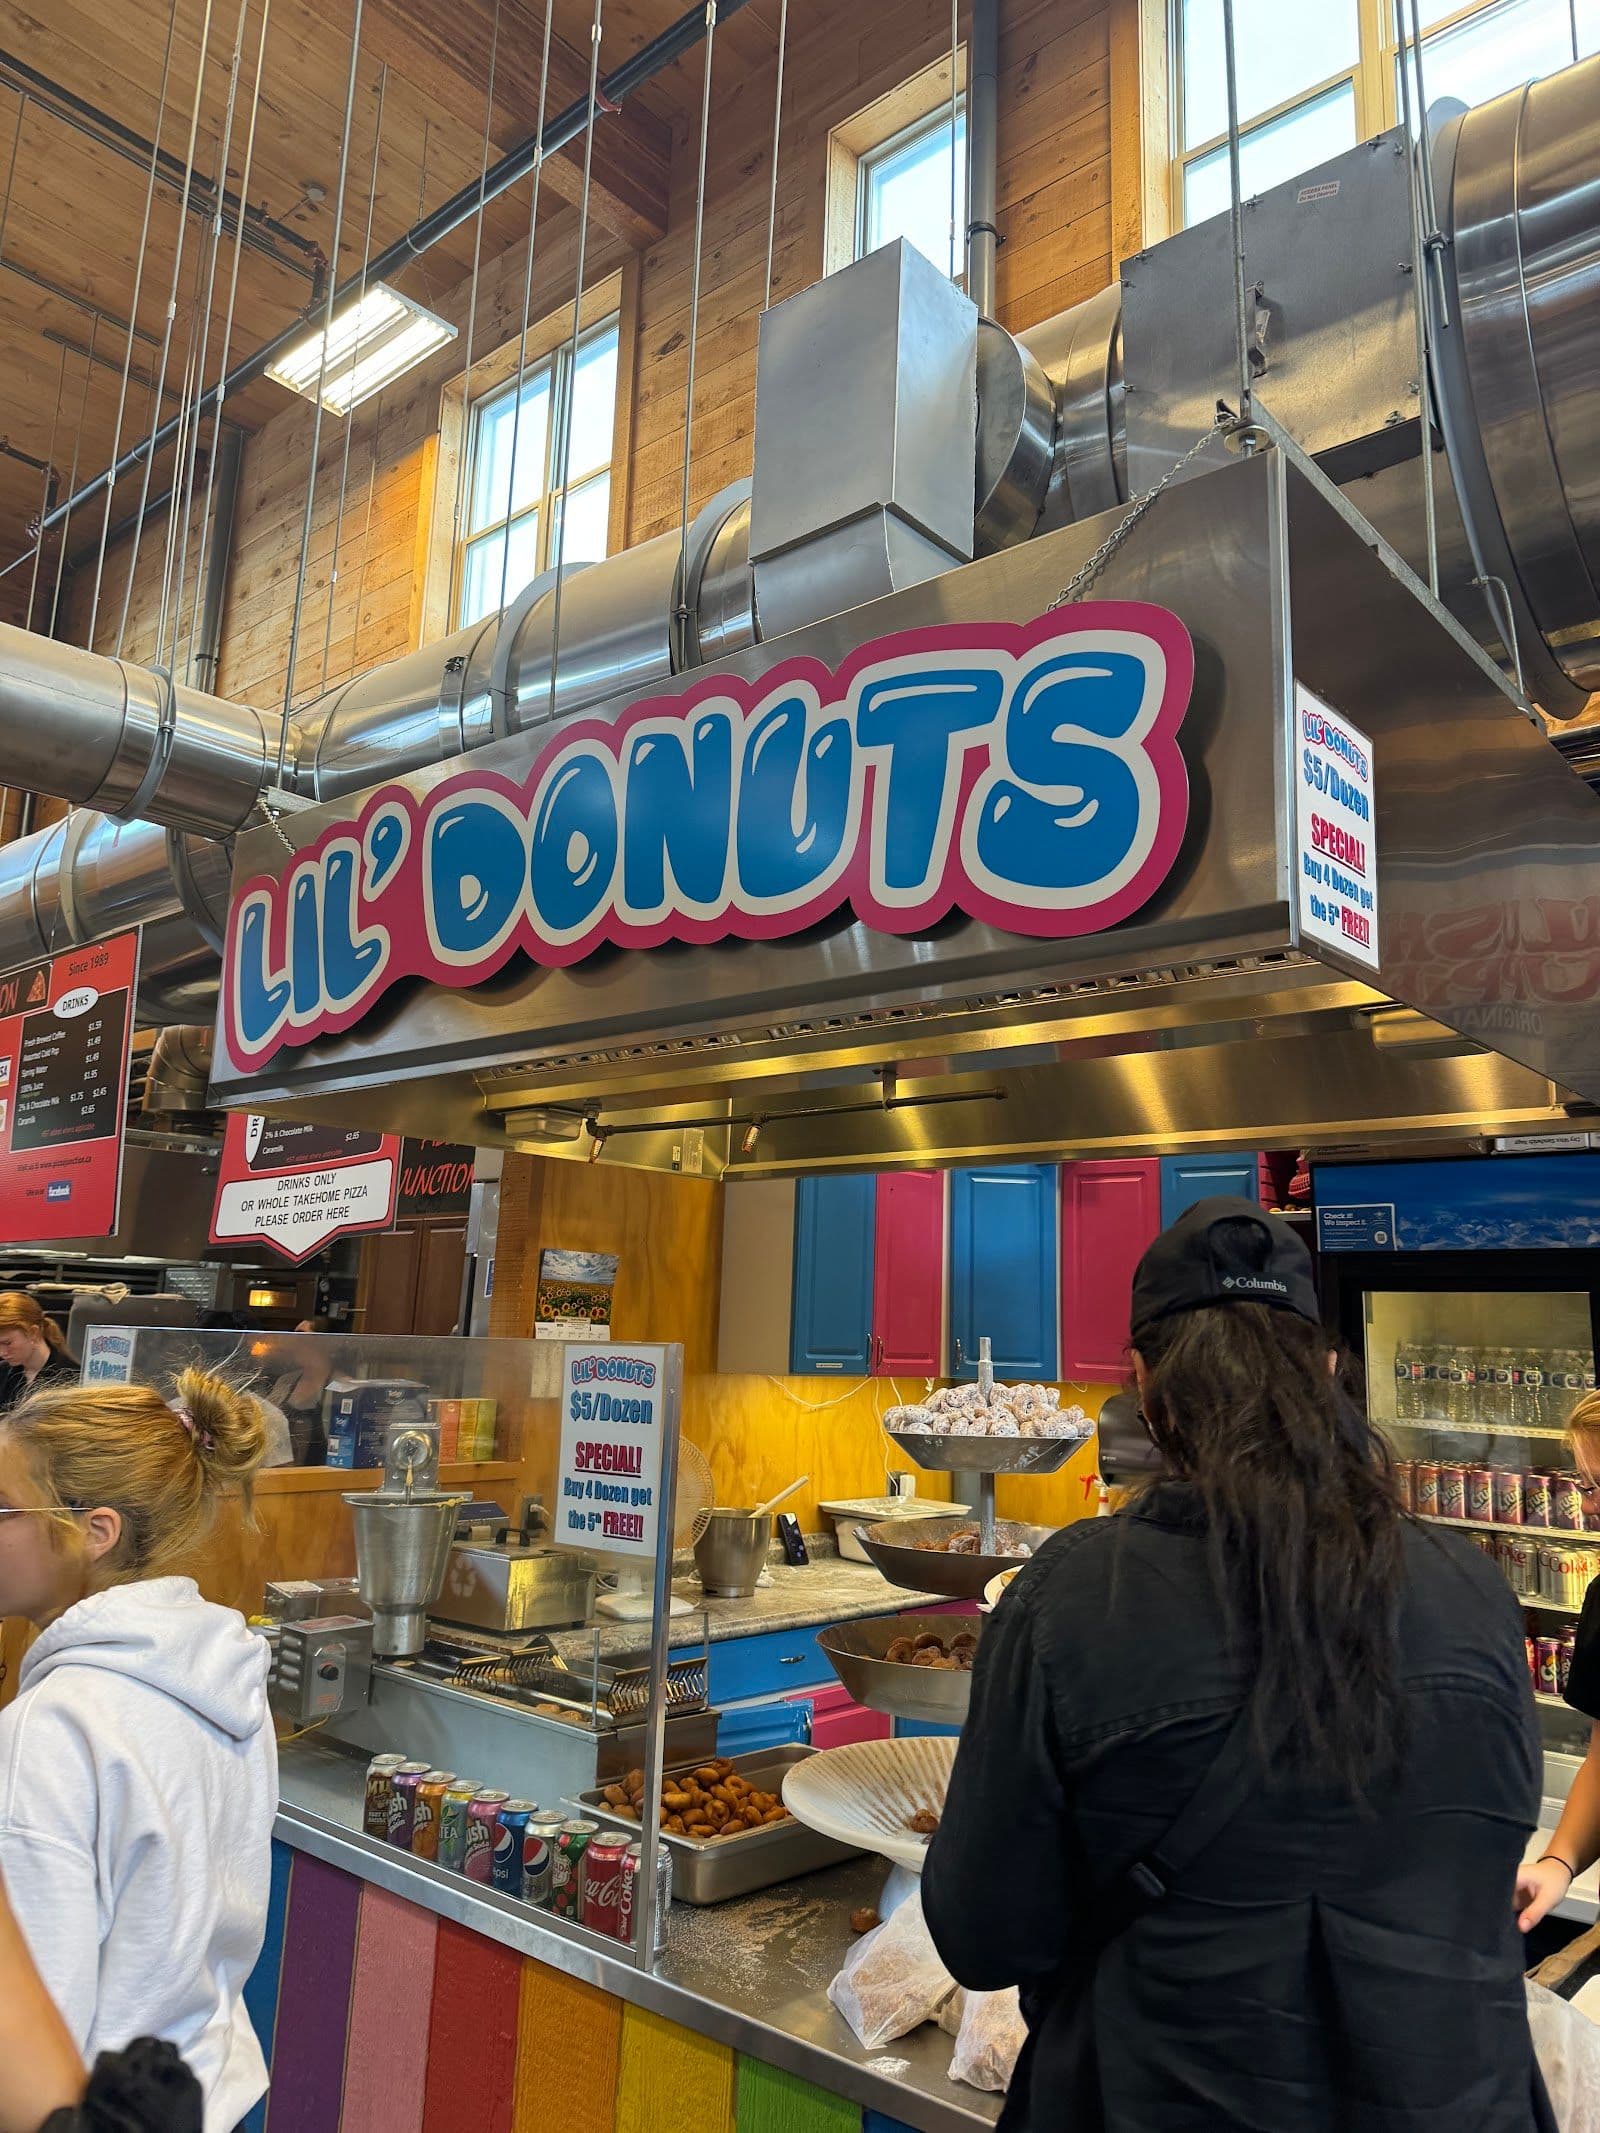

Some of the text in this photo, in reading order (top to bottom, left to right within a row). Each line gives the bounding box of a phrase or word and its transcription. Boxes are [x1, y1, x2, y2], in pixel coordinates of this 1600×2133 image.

[1323, 718, 1368, 781] DONUTS
[427, 636, 1160, 960] DONUTS
[1303, 748, 1369, 822] $5/Dozen
[1311, 813, 1366, 875] SPECIAL!
[1304, 852, 1373, 912] Buy 4 Dozen get
[1310, 894, 1327, 923] the
[68, 962, 88, 977] Since
[62, 994, 89, 1012] DRINKS
[279, 1127, 303, 1137] Chocolate
[278, 1173, 337, 1191] DRINKS ONLY
[241, 1185, 368, 1212] OR WHOLE TAKEHOME PIZZA
[255, 1206, 350, 1227] PLEASE ORDER HERE
[1235, 1277, 1288, 1292] Columbia
[597, 1357, 655, 1387] DONUTS
[570, 1390, 653, 1424] $5/Dozen
[575, 1441, 643, 1474] SPECIAL!
[564, 1477, 652, 1507] Buy 4 Dozen get
[568, 1509, 586, 1531] the
[440, 1826, 458, 1839] TEA
[620, 1868, 635, 1915] Coke
